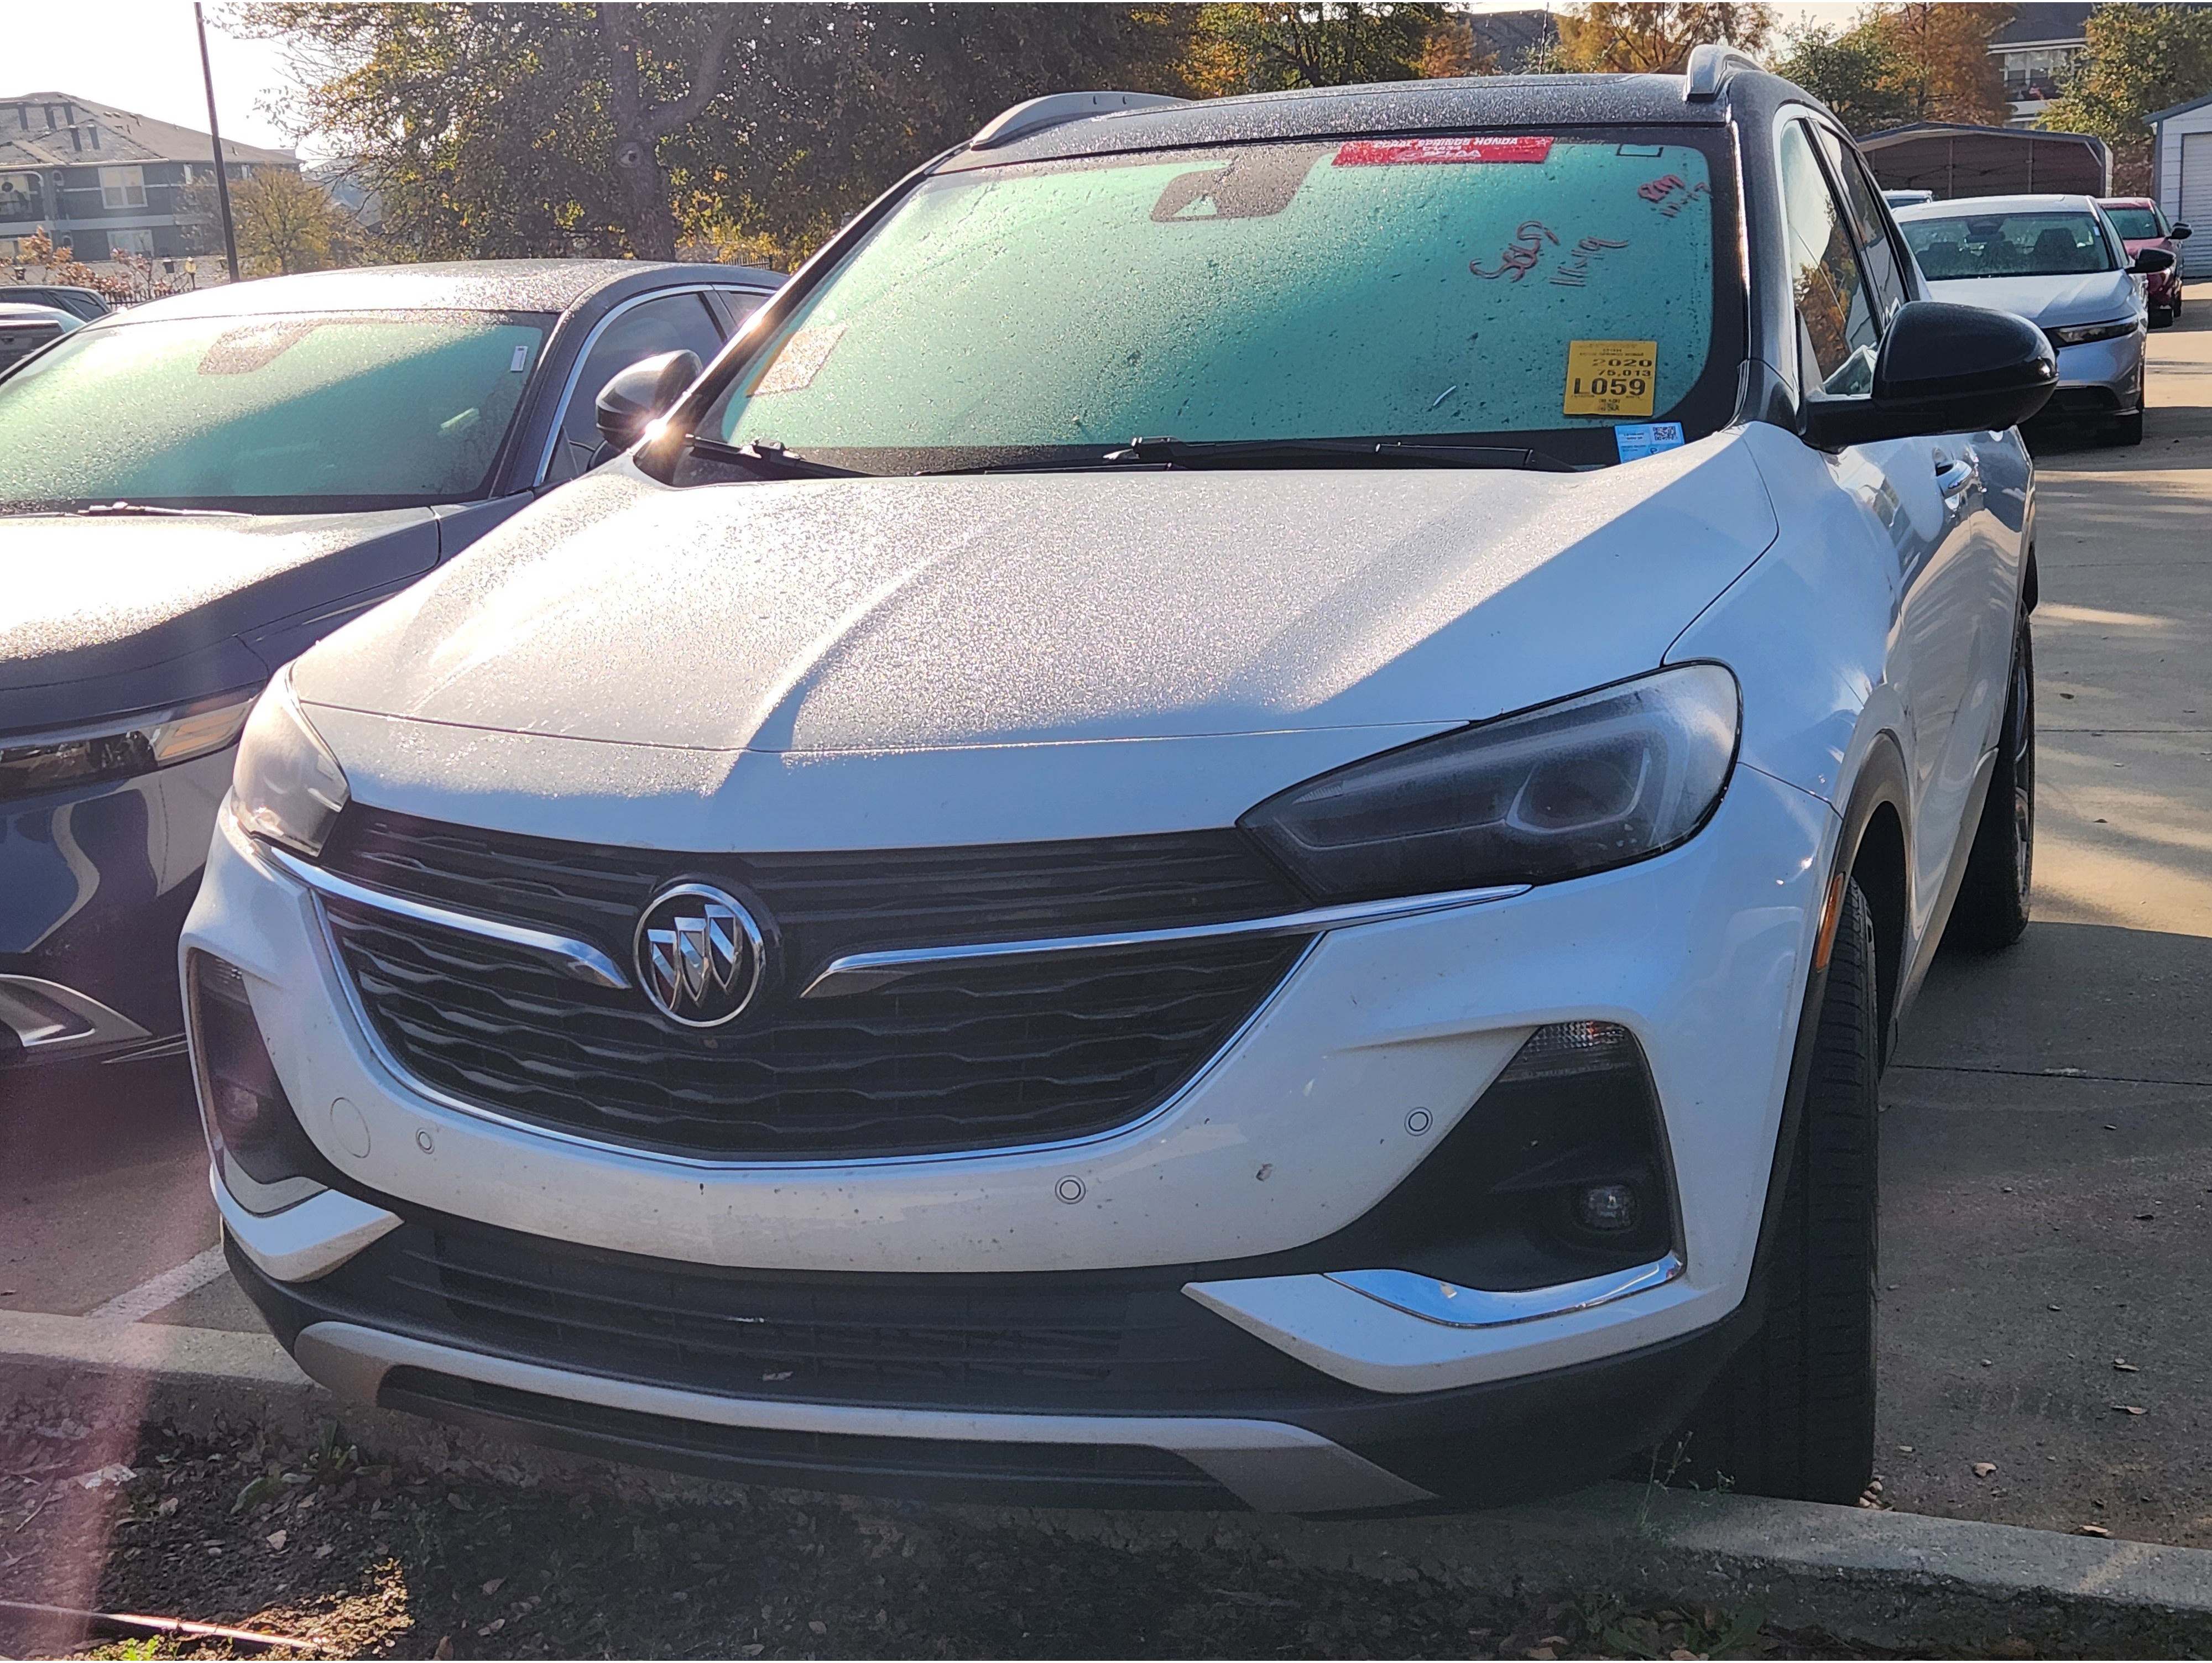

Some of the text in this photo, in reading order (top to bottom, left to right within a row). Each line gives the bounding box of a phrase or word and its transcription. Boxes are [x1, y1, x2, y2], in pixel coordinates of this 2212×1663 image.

[1473, 137, 1519, 146] HONDA
[1592, 359, 1652, 367] 2020
[1573, 378, 1646, 395] L059
